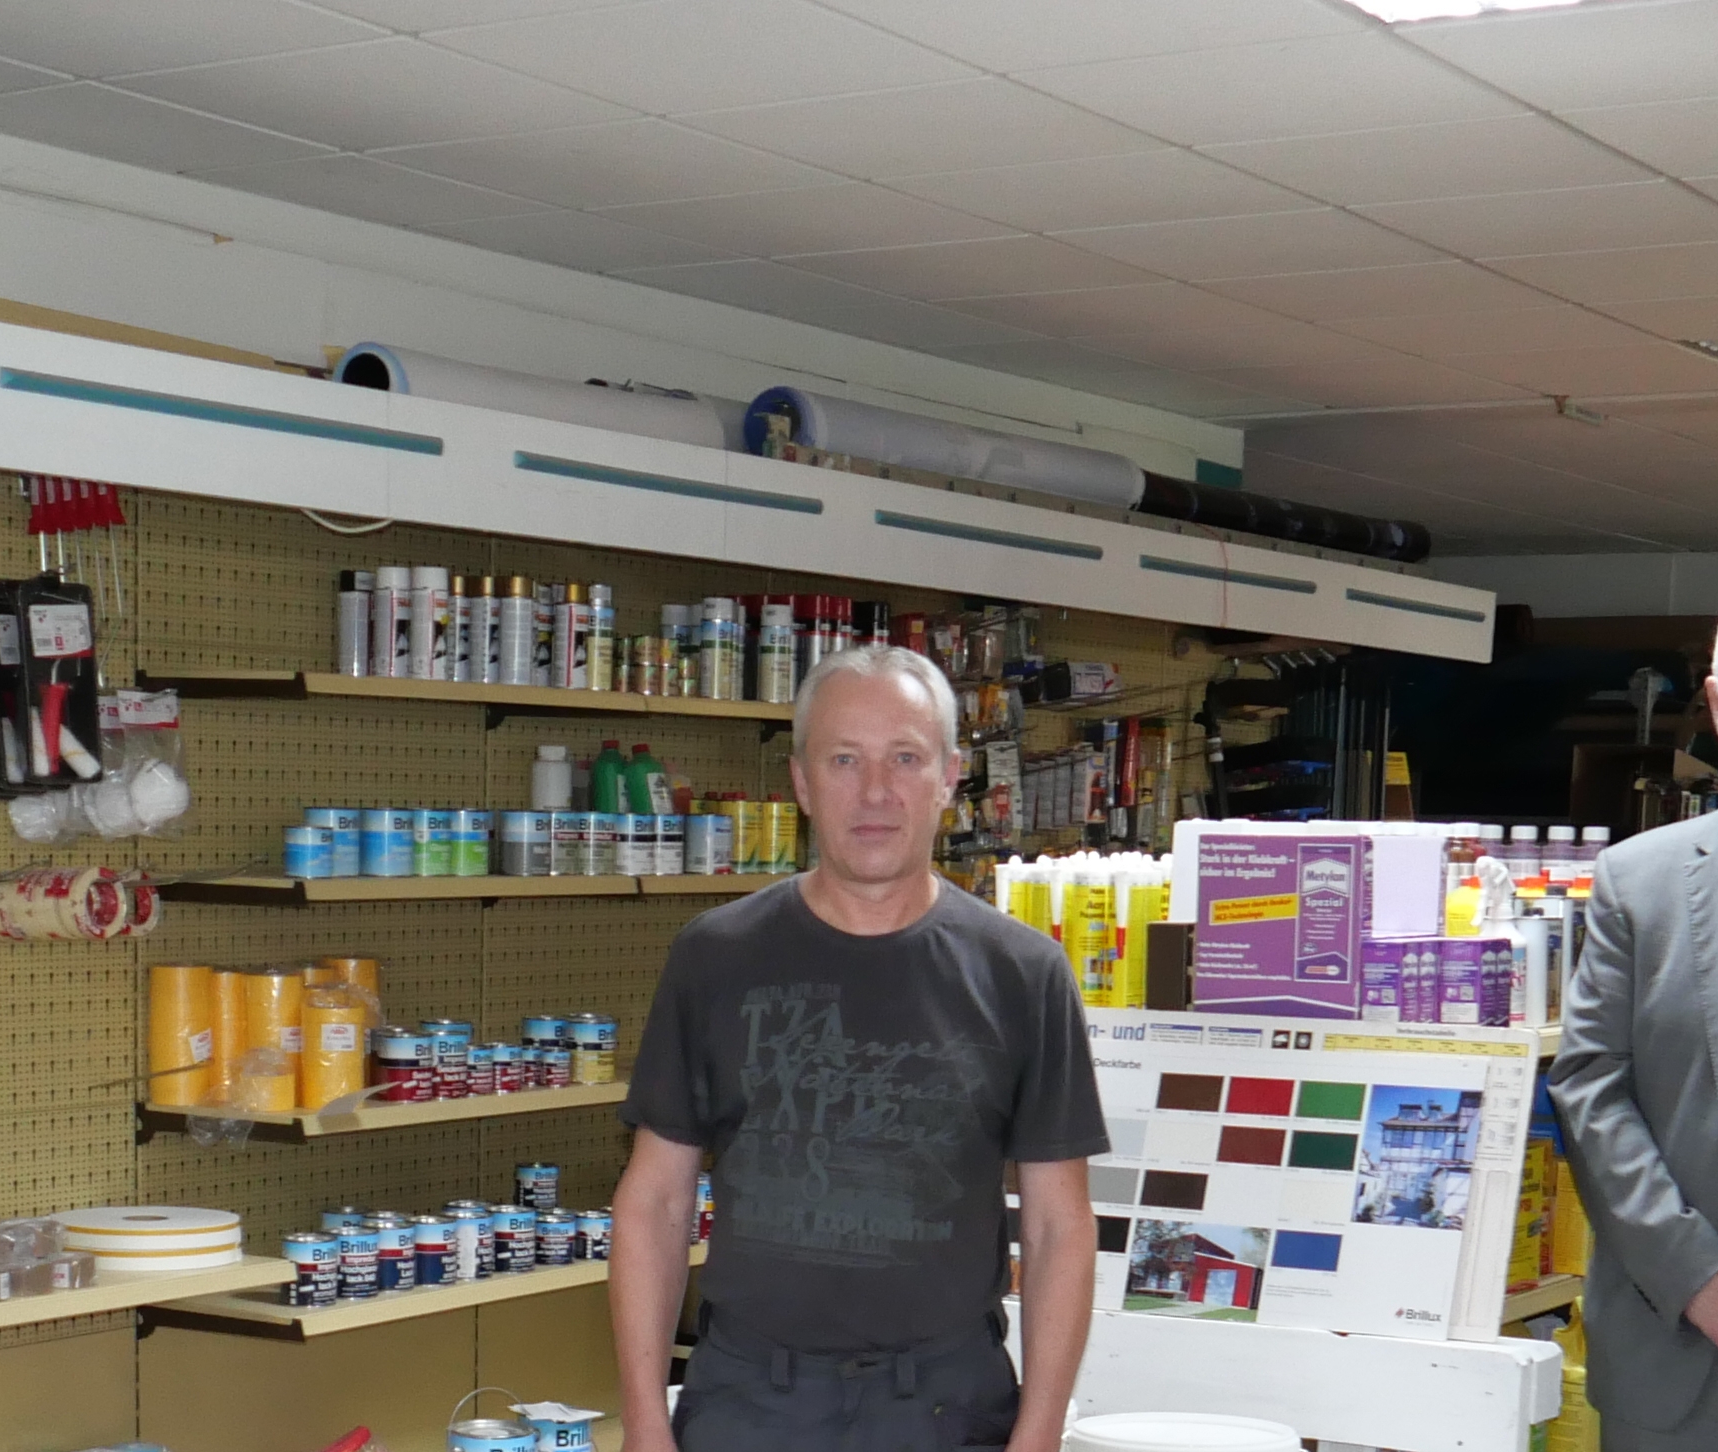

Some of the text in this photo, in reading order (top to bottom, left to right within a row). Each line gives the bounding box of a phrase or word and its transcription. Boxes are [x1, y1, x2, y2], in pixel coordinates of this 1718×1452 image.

[1199, 854, 1221, 863] Stark
[1222, 854, 1231, 863] in
[1232, 854, 1247, 864] der
[1305, 871, 1345, 883] Metylan
[1305, 897, 1343, 908] Spezial
[1112, 1023, 1146, 1041] und
[1405, 1309, 1442, 1322] Brillux
